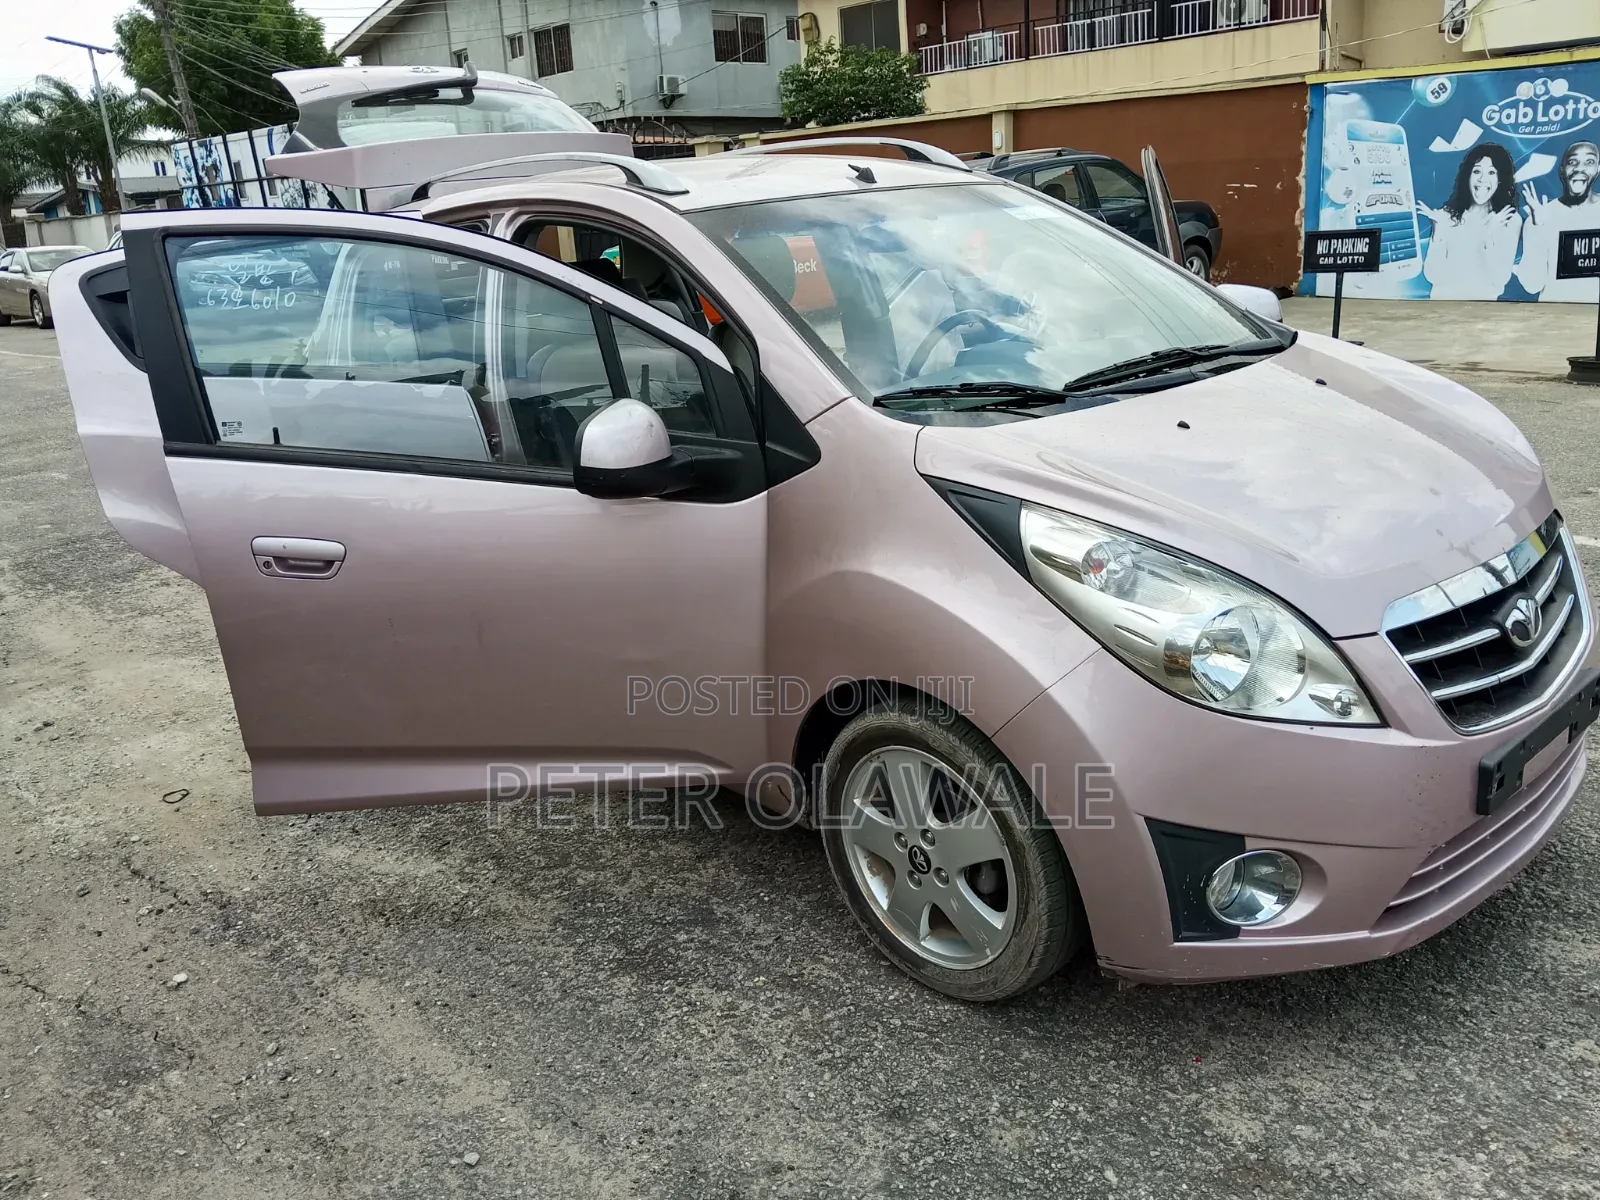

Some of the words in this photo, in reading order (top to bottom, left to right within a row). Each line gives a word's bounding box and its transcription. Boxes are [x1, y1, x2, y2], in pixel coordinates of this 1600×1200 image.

[1430, 82, 1448, 99] 59
[1482, 101, 1533, 126] Gab
[1537, 98, 1600, 122] Lotto
[1518, 125, 1535, 134] Get
[1536, 123, 1560, 134] paid!
[1316, 239, 1330, 255] NO
[1330, 237, 1370, 254] PARKING
[1573, 237, 1589, 256] NO
[1336, 255, 1365, 264] LOTTO
